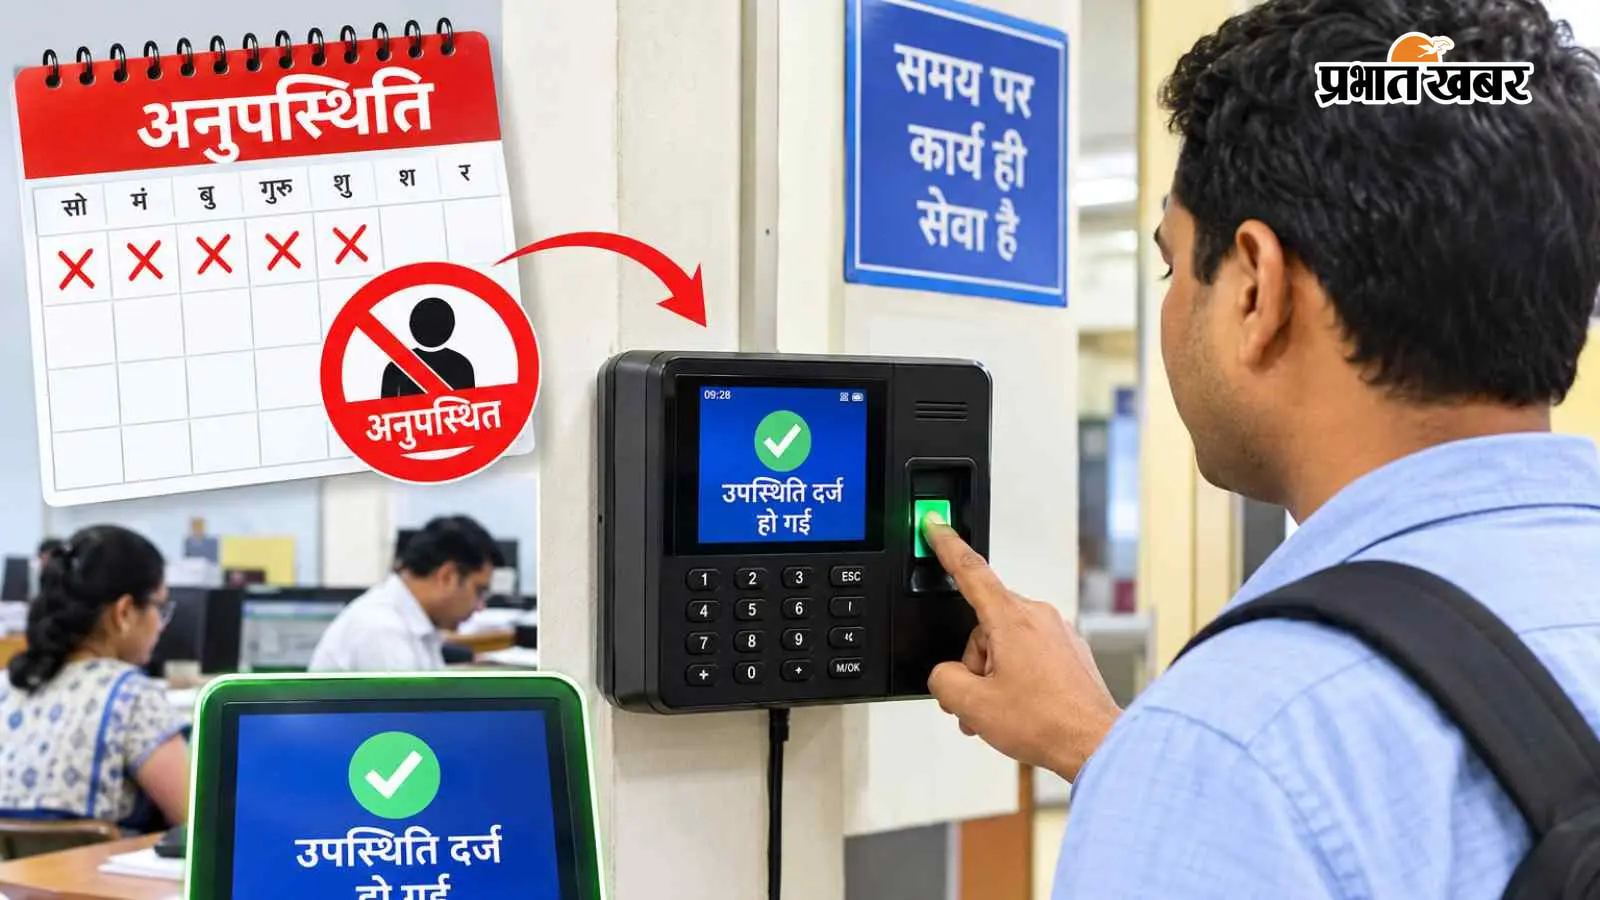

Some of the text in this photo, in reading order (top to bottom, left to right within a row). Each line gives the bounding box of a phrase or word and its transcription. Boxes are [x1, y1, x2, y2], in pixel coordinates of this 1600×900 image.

[893, 43, 1035, 119] समय पर
[137, 66, 435, 163] अनुपस्थिति
[907, 121, 1028, 192] कार्य ही
[62, 164, 472, 217] सो मं बु गुरु शु श र
[916, 185, 1021, 262] सेवा है
[703, 389, 732, 400] 09:28
[366, 395, 502, 450] अनुपस्थित
[721, 476, 845, 504] उपस्थिति दर्ज
[757, 507, 813, 537] हो गई
[701, 570, 861, 586] 1 2 3 ESC
[699, 601, 804, 618] 4 5 6
[699, 632, 803, 650] 7 8 9
[747, 665, 756, 680] 0
[836, 662, 861, 673] M/OK
[294, 824, 503, 868] उपस्थिति दर्ज
